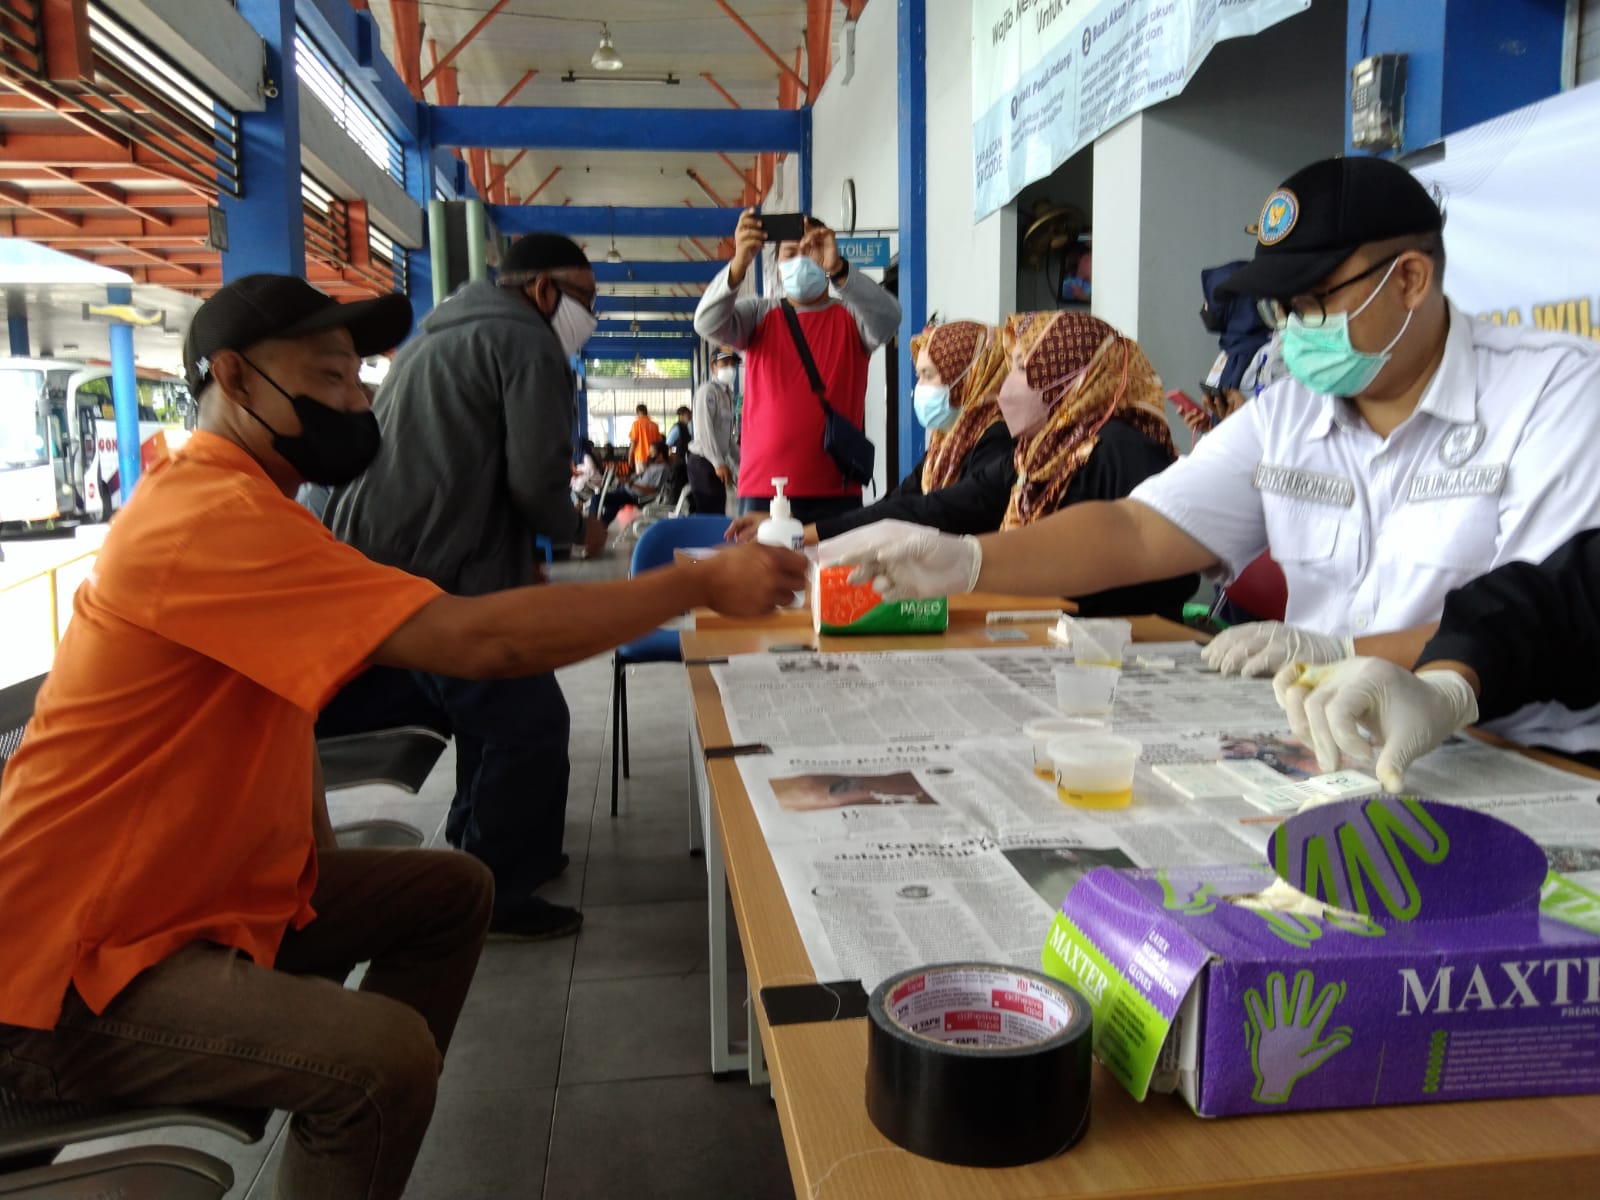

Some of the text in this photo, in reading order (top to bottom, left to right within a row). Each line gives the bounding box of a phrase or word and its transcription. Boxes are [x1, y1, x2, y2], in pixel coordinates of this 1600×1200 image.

[1036, 0, 1064, 34] Untuk
[1150, 2, 1175, 21] akun
[992, 8, 1014, 48] Wajib
[1145, 25, 1164, 41] dan
[1147, 65, 1185, 92] tersebut
[984, 153, 1003, 182] CODE
[839, 243, 884, 258] TOILET
[1412, 468, 1501, 498] TULUNGAGUNG
[900, 600, 942, 617] PASEO
[1049, 923, 1109, 1001] MAXTER
[1004, 991, 1043, 1012] adhesive
[956, 1012, 1001, 1021] adhesive
[1023, 1002, 1043, 1020] tape
[920, 1016, 941, 1029] TAPE
[976, 1020, 1001, 1031] tape
[955, 1037, 979, 1045] TAPE
